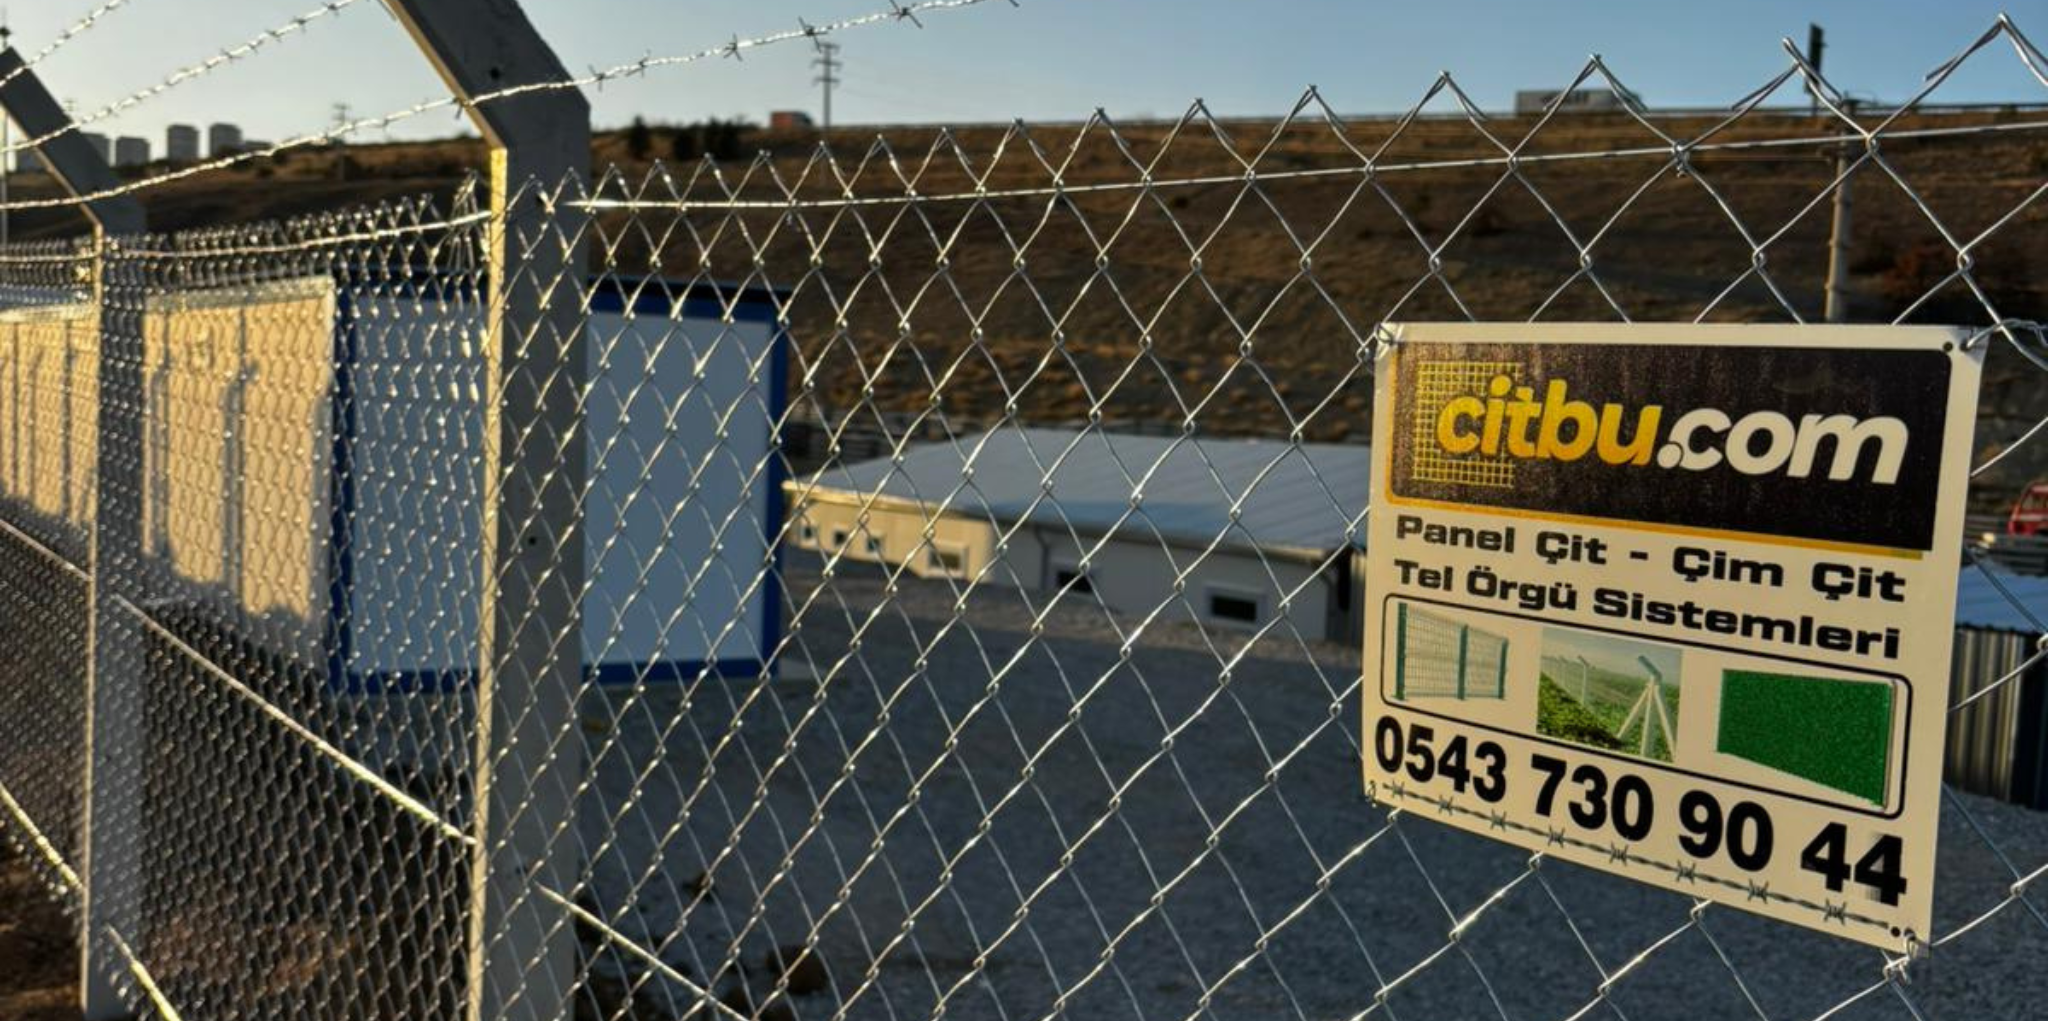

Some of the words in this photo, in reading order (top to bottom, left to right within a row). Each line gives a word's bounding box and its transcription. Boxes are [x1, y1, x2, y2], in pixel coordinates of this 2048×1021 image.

[1436, 374, 1909, 485] citbu.com
[1394, 560, 1452, 592] Tel
[1466, 564, 1577, 611] Örgü
[1593, 588, 1901, 660] Sistemleri
[1397, 514, 1515, 553] Panel
[1536, 530, 1607, 567] Çit
[1672, 546, 1784, 588] Çim
[1811, 562, 1906, 603] Çit
[1374, 716, 1506, 803] 0543
[1530, 754, 1654, 841] 730
[1678, 789, 1774, 872] 90
[1801, 822, 1907, 907] 44
